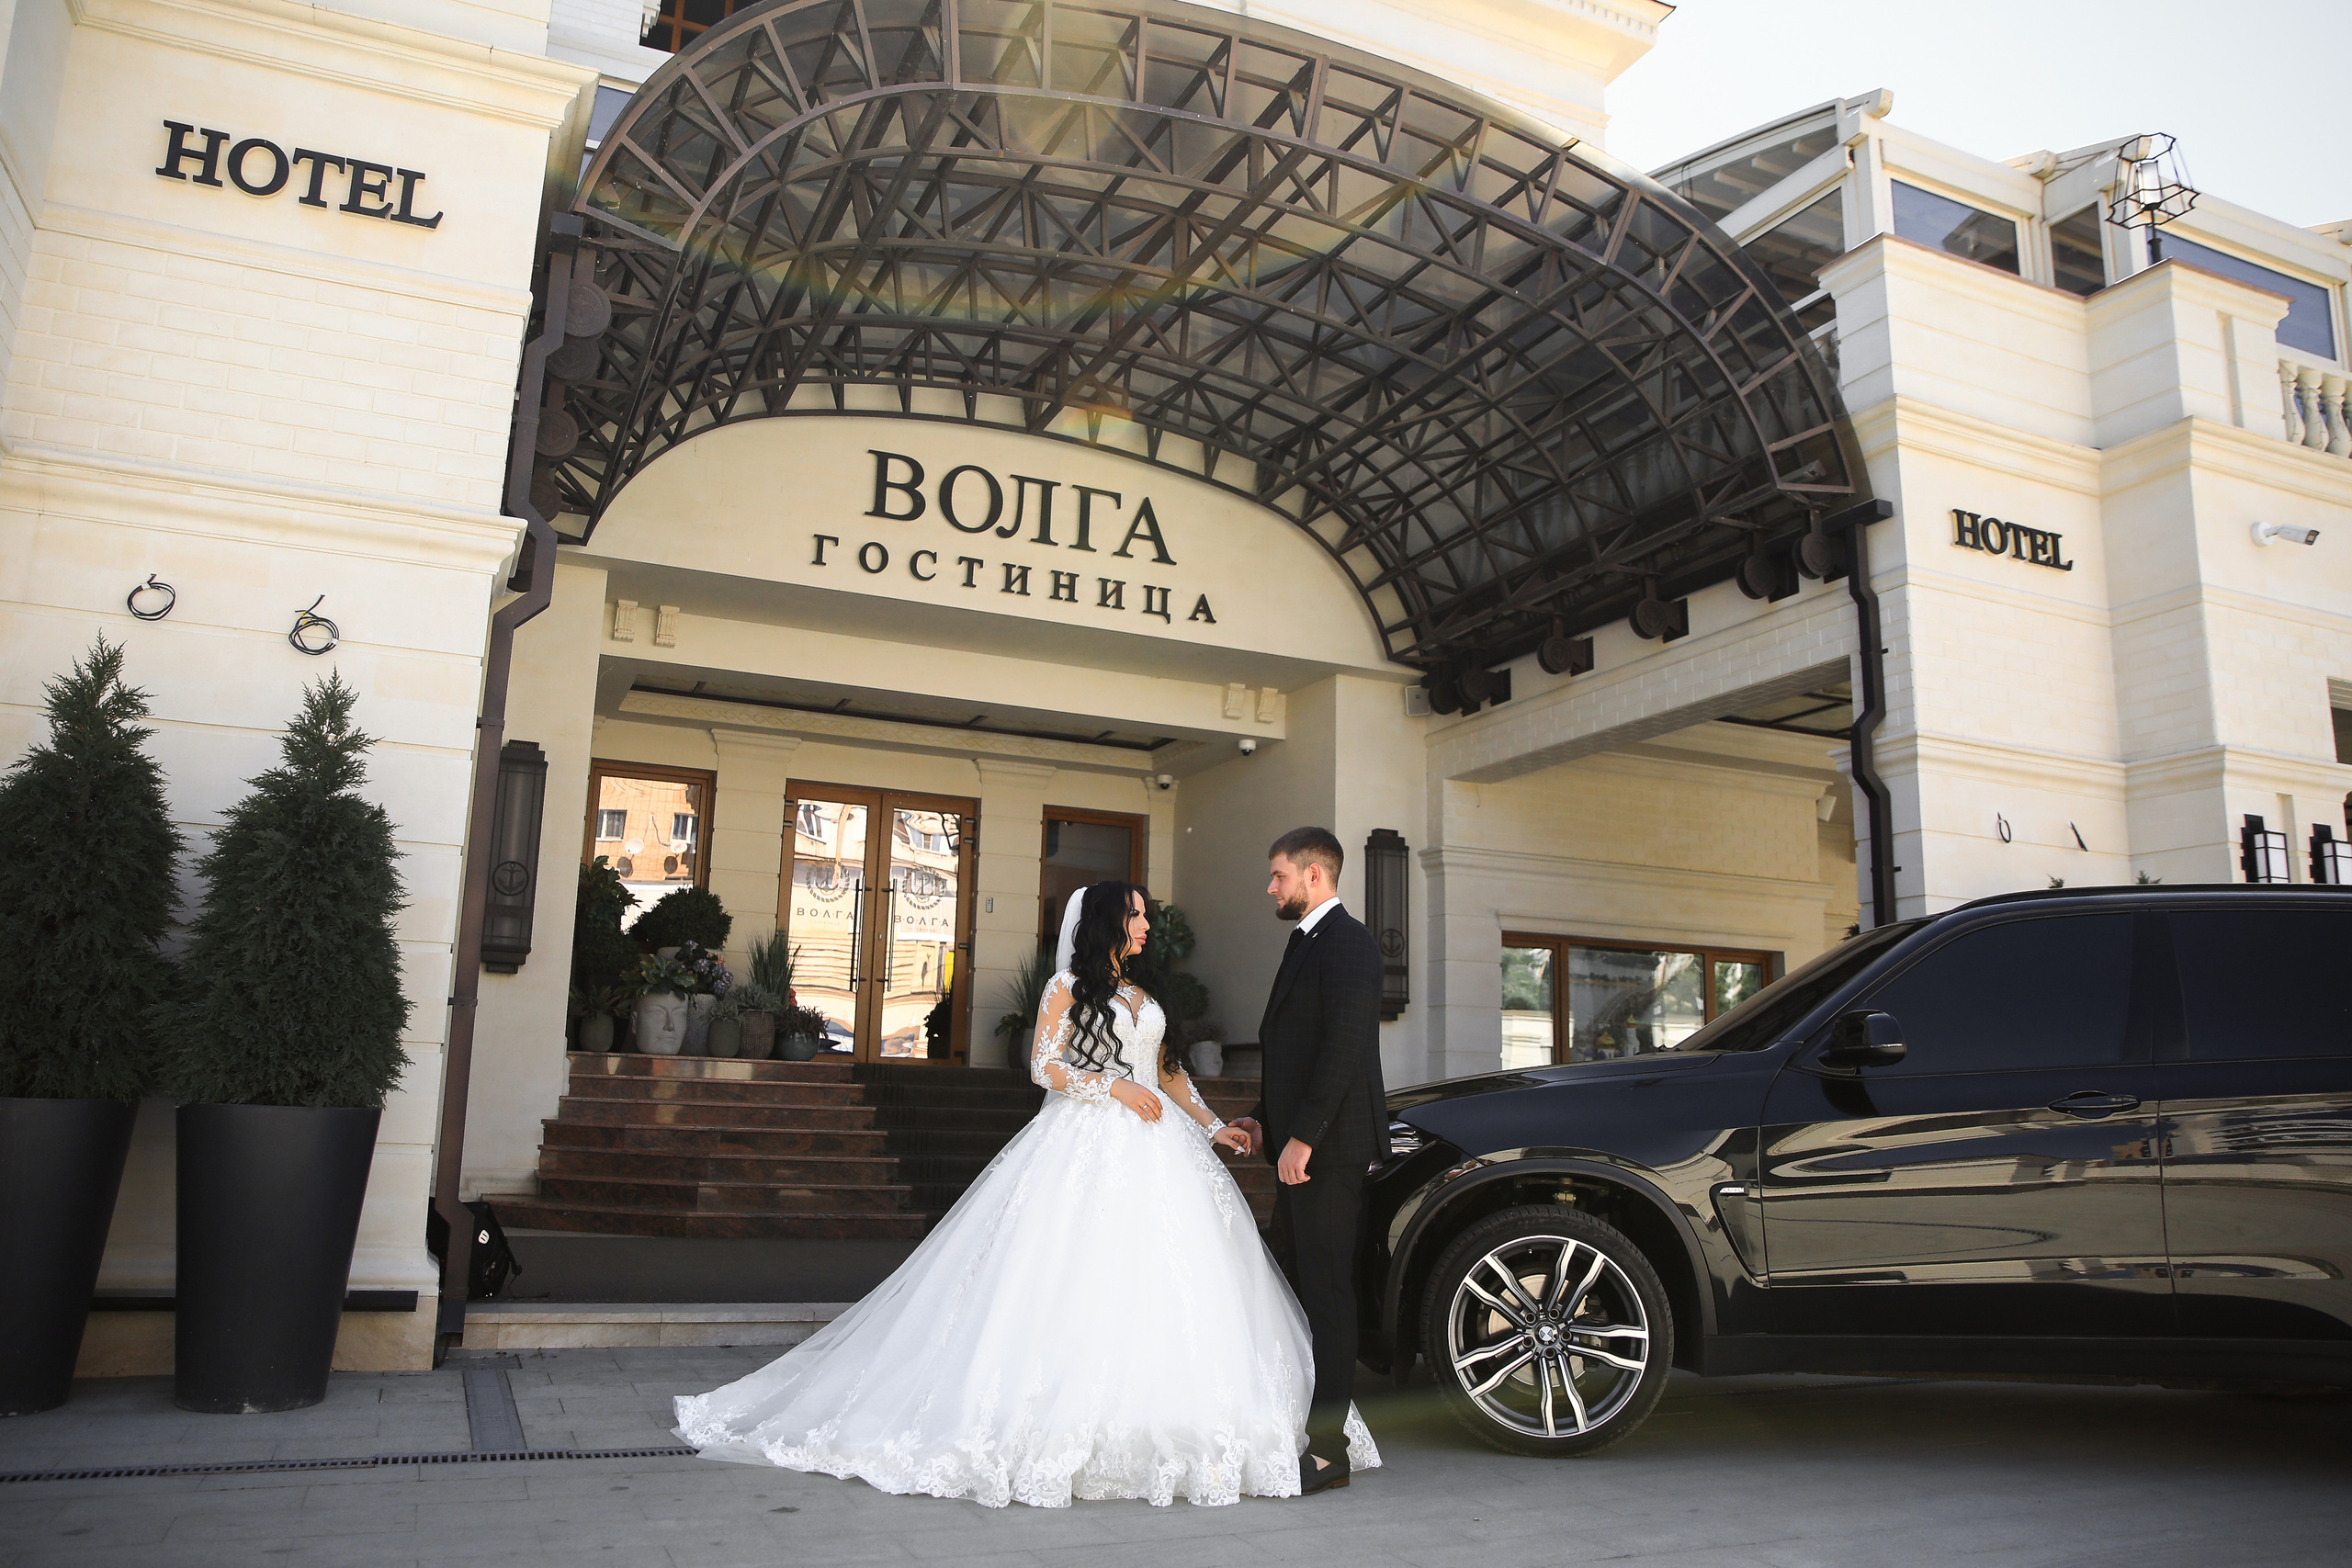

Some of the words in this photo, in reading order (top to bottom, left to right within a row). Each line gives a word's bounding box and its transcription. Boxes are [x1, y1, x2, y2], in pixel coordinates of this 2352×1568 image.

[156, 119, 443, 230] HOTEL
[863, 449, 1177, 566] ВОЛГА
[1952, 509, 2073, 571] HOTEL
[811, 533, 1217, 625] ГОСТИНИЦА
